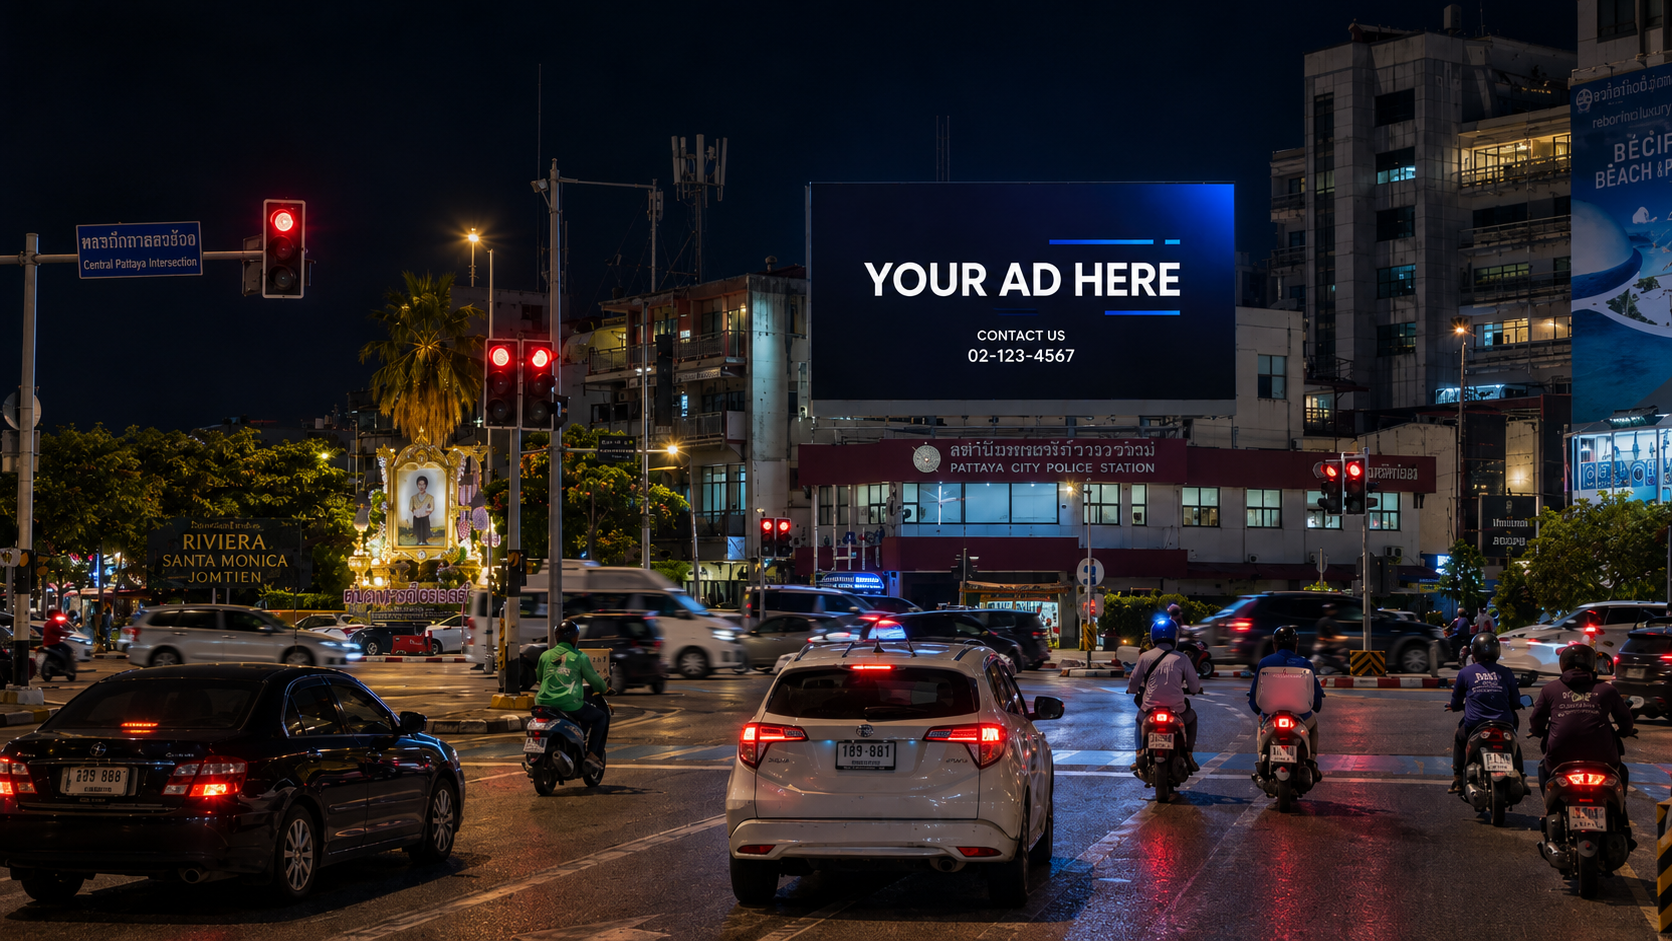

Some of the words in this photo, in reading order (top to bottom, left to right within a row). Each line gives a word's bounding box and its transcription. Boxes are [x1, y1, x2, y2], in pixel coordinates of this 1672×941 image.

[83, 258, 113, 270] Central
[115, 258, 146, 271] Pattaya
[149, 256, 197, 268] Intersection
[864, 262, 987, 297] YOUR
[998, 262, 1062, 297] AD
[1074, 262, 1181, 297] HERE
[976, 330, 1043, 342] CONTACT
[1047, 330, 1066, 342] US
[967, 348, 1075, 363] 02-123-4567
[950, 462, 1005, 473] PATTAYA
[1011, 462, 1041, 473] CITY
[1046, 462, 1093, 473] POLICE
[1100, 462, 1155, 473] STATION
[182, 533, 266, 550] RIVIERA
[162, 554, 216, 568] SANTA
[221, 554, 289, 568] MONICA
[188, 571, 262, 583] JOMTIEN
